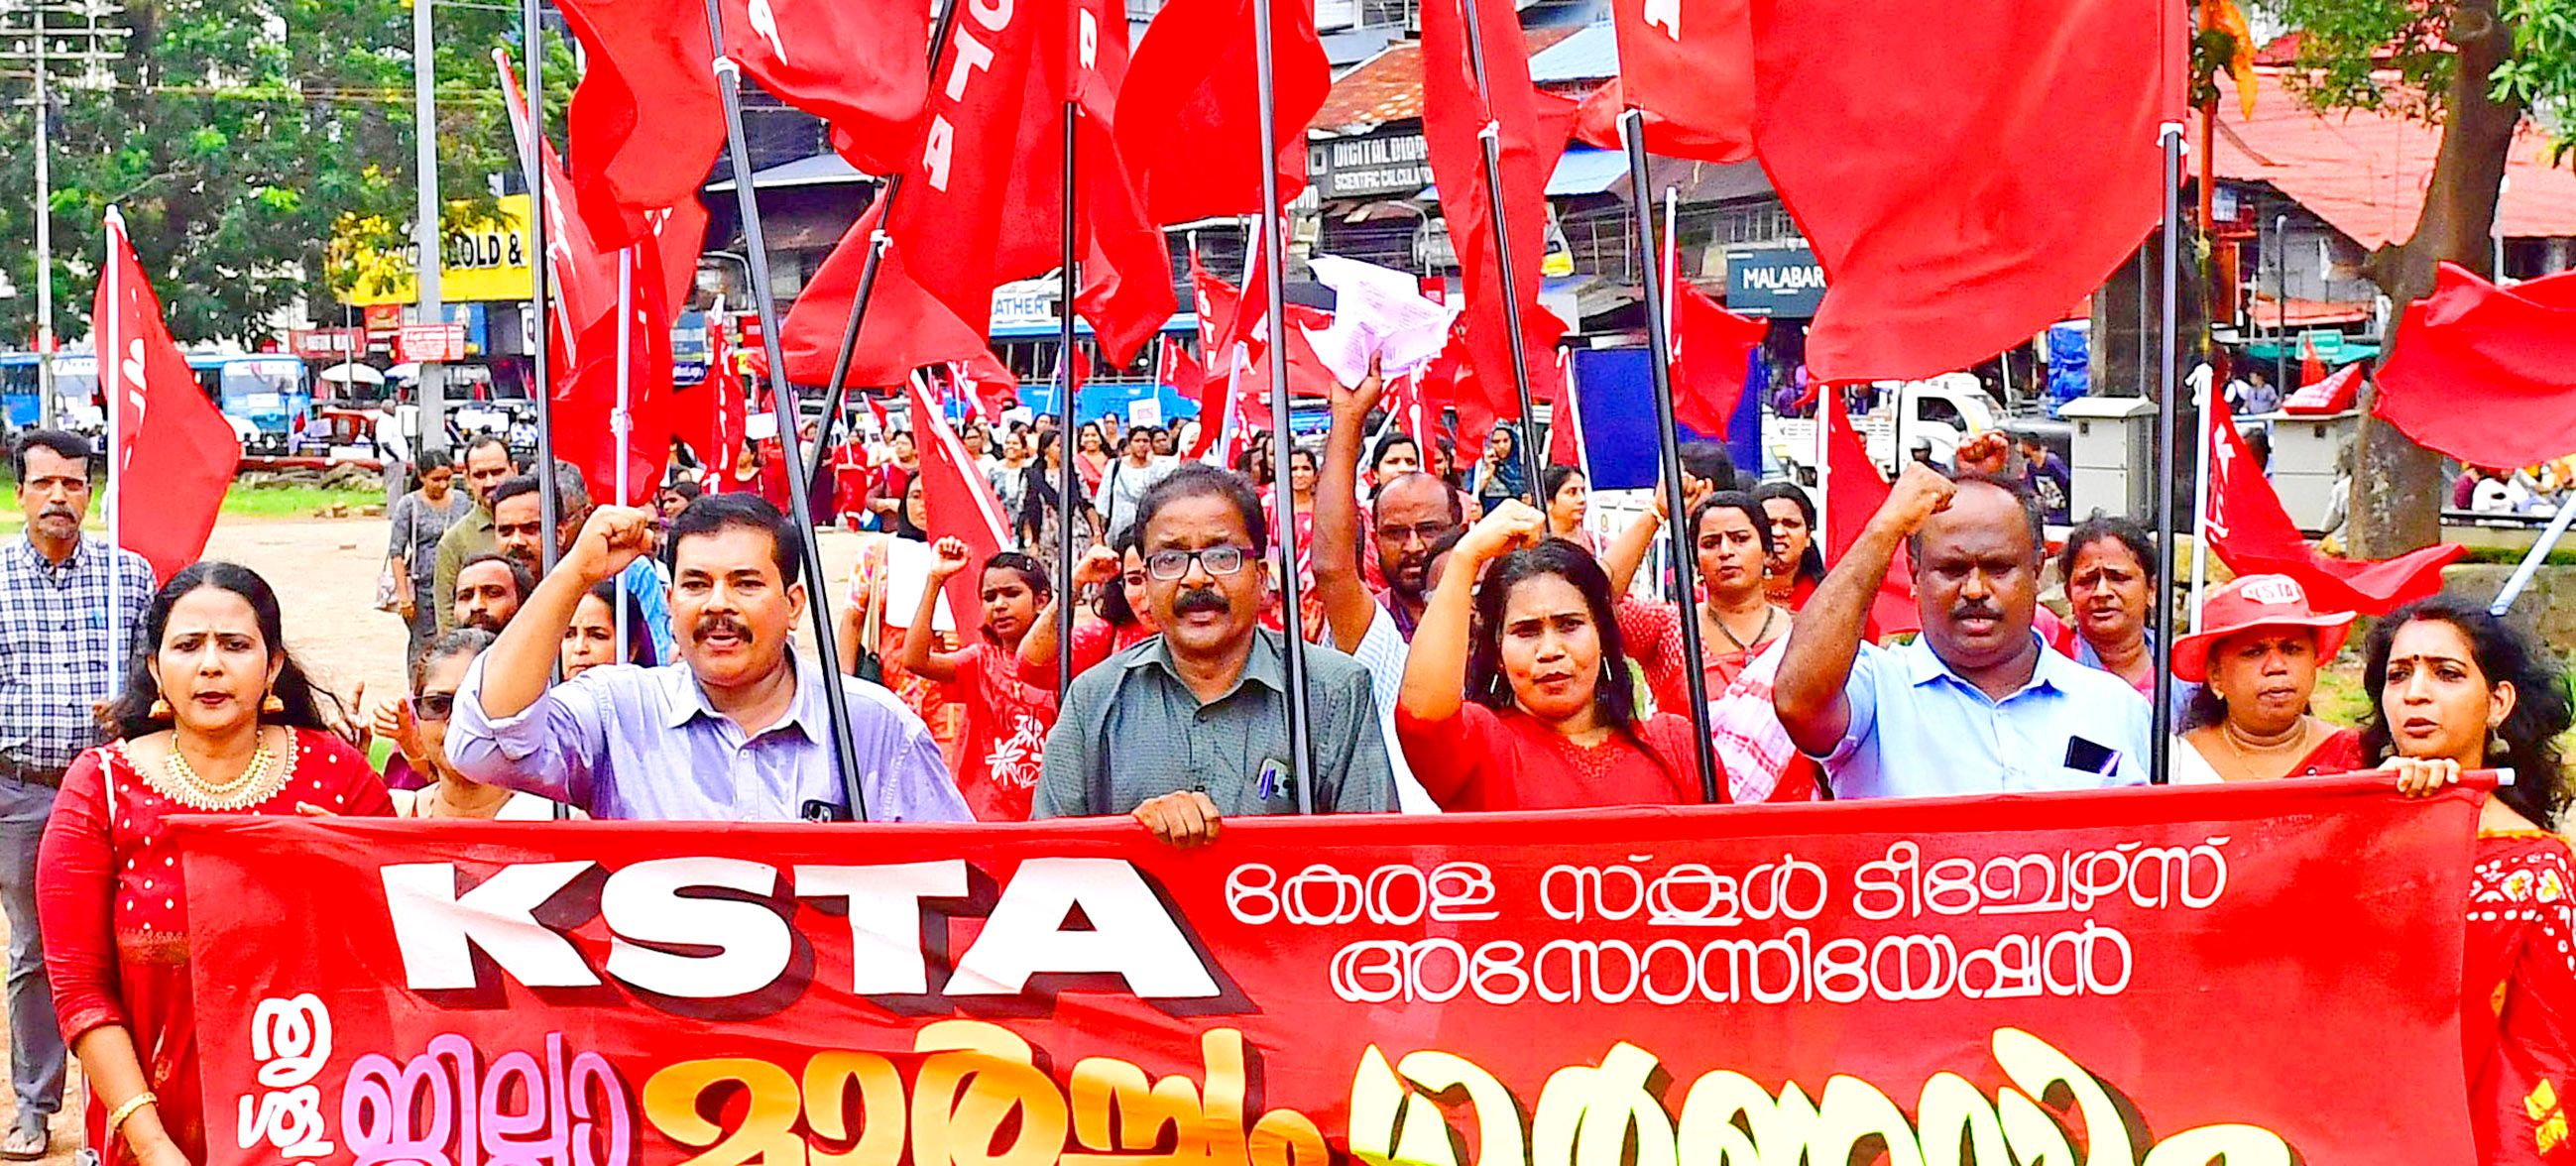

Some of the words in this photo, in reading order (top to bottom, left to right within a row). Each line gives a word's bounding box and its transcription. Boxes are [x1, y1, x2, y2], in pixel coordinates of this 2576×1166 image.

[1333, 138, 1390, 168] DIGITAL
[1390, 135, 1429, 163] DIAR
[1335, 171, 1380, 190] SCIENTIFIC
[1742, 266, 1826, 289] MALABAR
[381, 856, 1222, 998] KSTA
[1226, 861, 1499, 926] കേരള
[1540, 853, 1828, 927] സ്കൂൾ
[1330, 918, 2133, 1005] അസോസിയേഷൻ
[238, 992, 334, 1166] തൃശൂ
